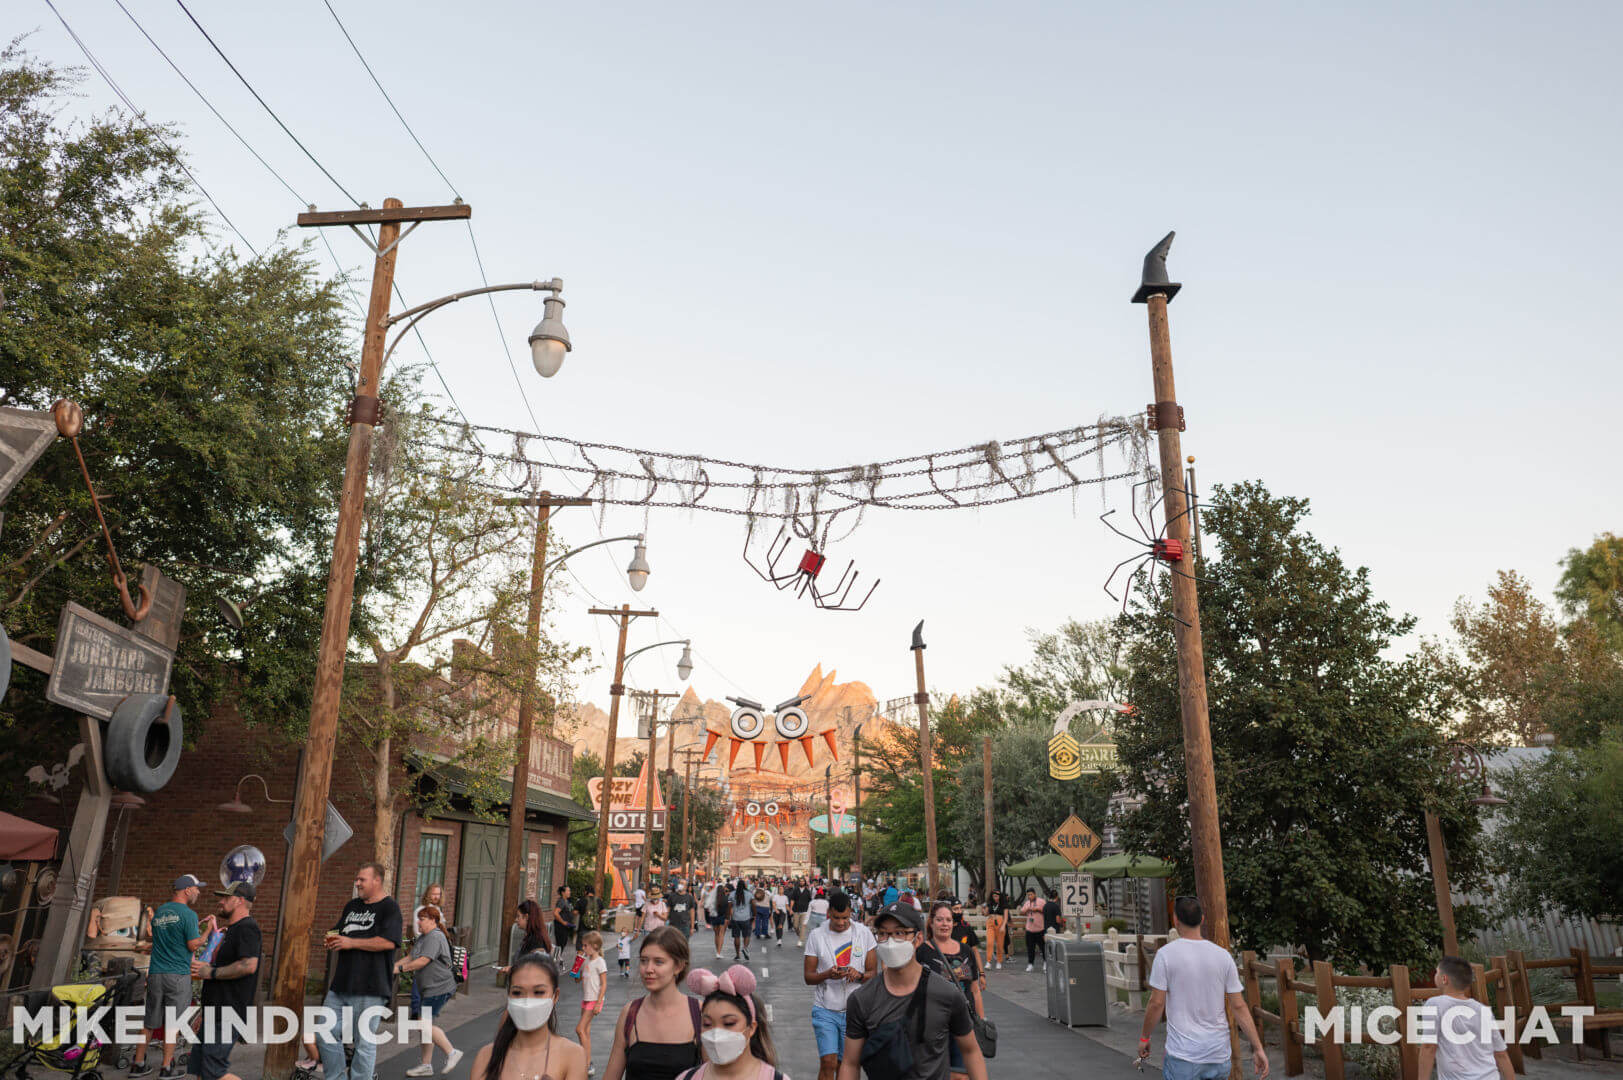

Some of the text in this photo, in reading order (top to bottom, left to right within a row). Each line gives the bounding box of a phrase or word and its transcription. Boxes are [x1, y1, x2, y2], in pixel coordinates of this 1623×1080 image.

[70, 640, 146, 672] JUNKYARD
[85, 667, 158, 694] JAMBOREE
[1057, 833, 1092, 848] SLOW
[1061, 875, 1091, 883] SPEED LIMIT
[1066, 885, 1089, 905] 25
